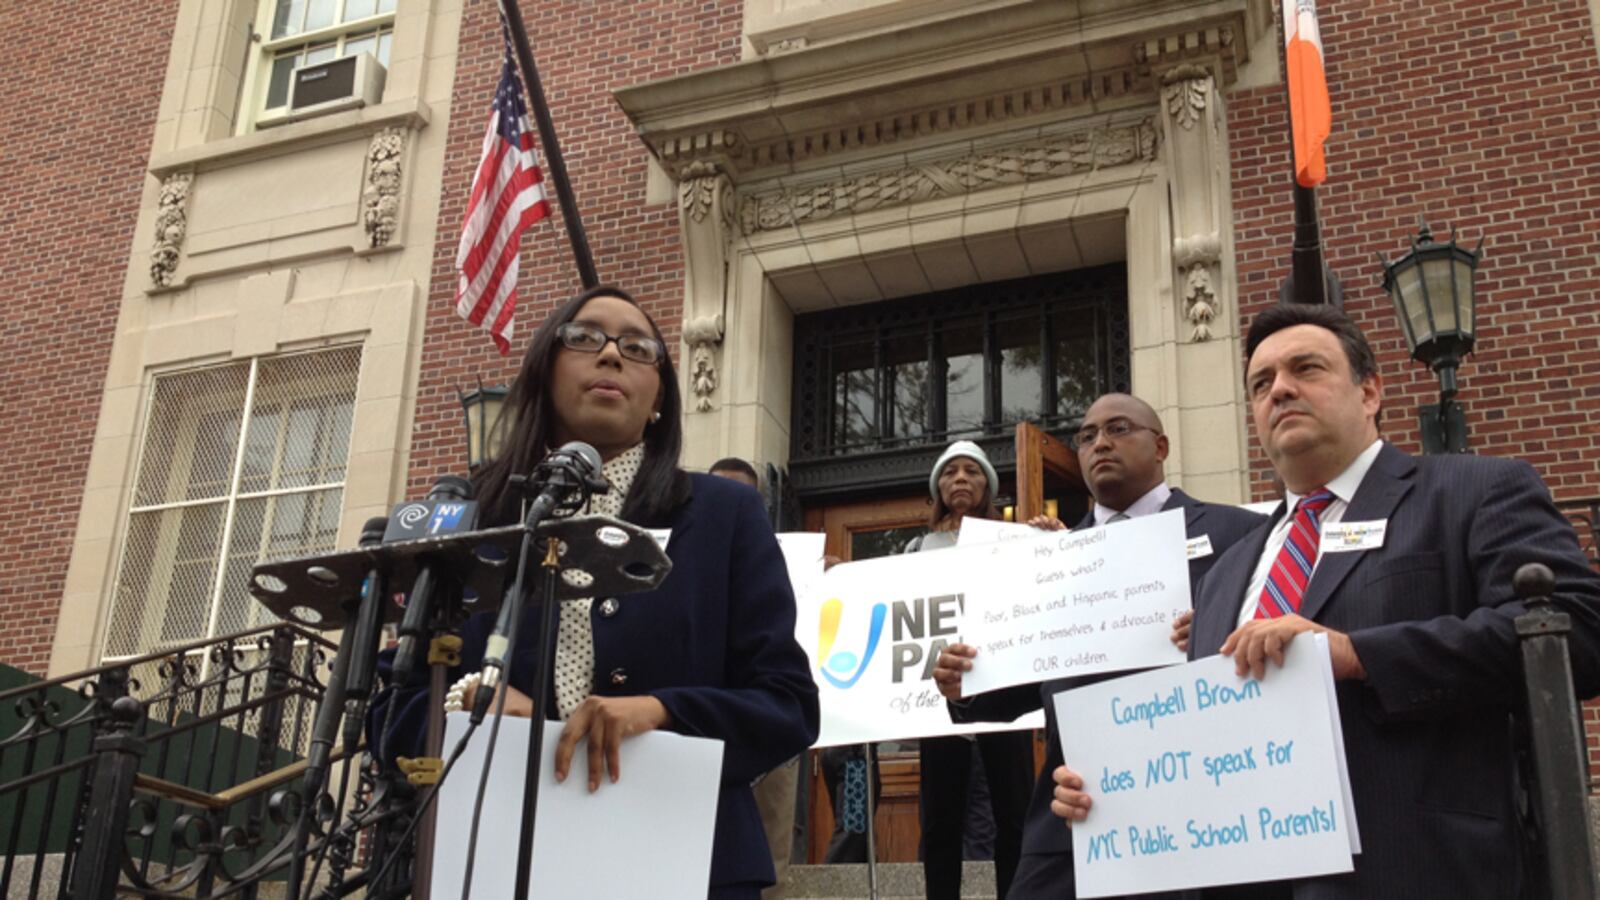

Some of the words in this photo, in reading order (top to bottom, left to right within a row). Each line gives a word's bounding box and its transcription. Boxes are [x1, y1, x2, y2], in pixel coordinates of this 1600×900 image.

[438, 505, 464, 516] NY
[431, 518, 443, 534] 1
[1034, 546, 1054, 558] Hey
[1059, 529, 1107, 553] Campbell!
[1035, 569, 1065, 585] Guess
[1070, 557, 1105, 577] what?
[984, 610, 1008, 625] Poor,
[1013, 603, 1041, 619] Black
[1046, 595, 1067, 611] and
[1073, 588, 1118, 606] Hispanic
[1124, 579, 1166, 601] parents
[987, 636, 1014, 655] speak
[1019, 633, 1034, 646] for
[1111, 611, 1166, 630] advocate
[1032, 655, 1059, 673] OUR
[889, 692, 912, 713] of
[915, 690, 940, 708] the
[1111, 686, 1186, 729] Campbell
[1195, 678, 1261, 711] Brown
[1100, 767, 1135, 794] does
[1145, 751, 1192, 788] NOT
[1203, 746, 1257, 786] speak
[1266, 740, 1294, 766] for
[1086, 829, 1122, 864] NYC
[1128, 825, 1179, 857] Public
[1186, 814, 1249, 849] School
[1258, 800, 1336, 840] Parents!
